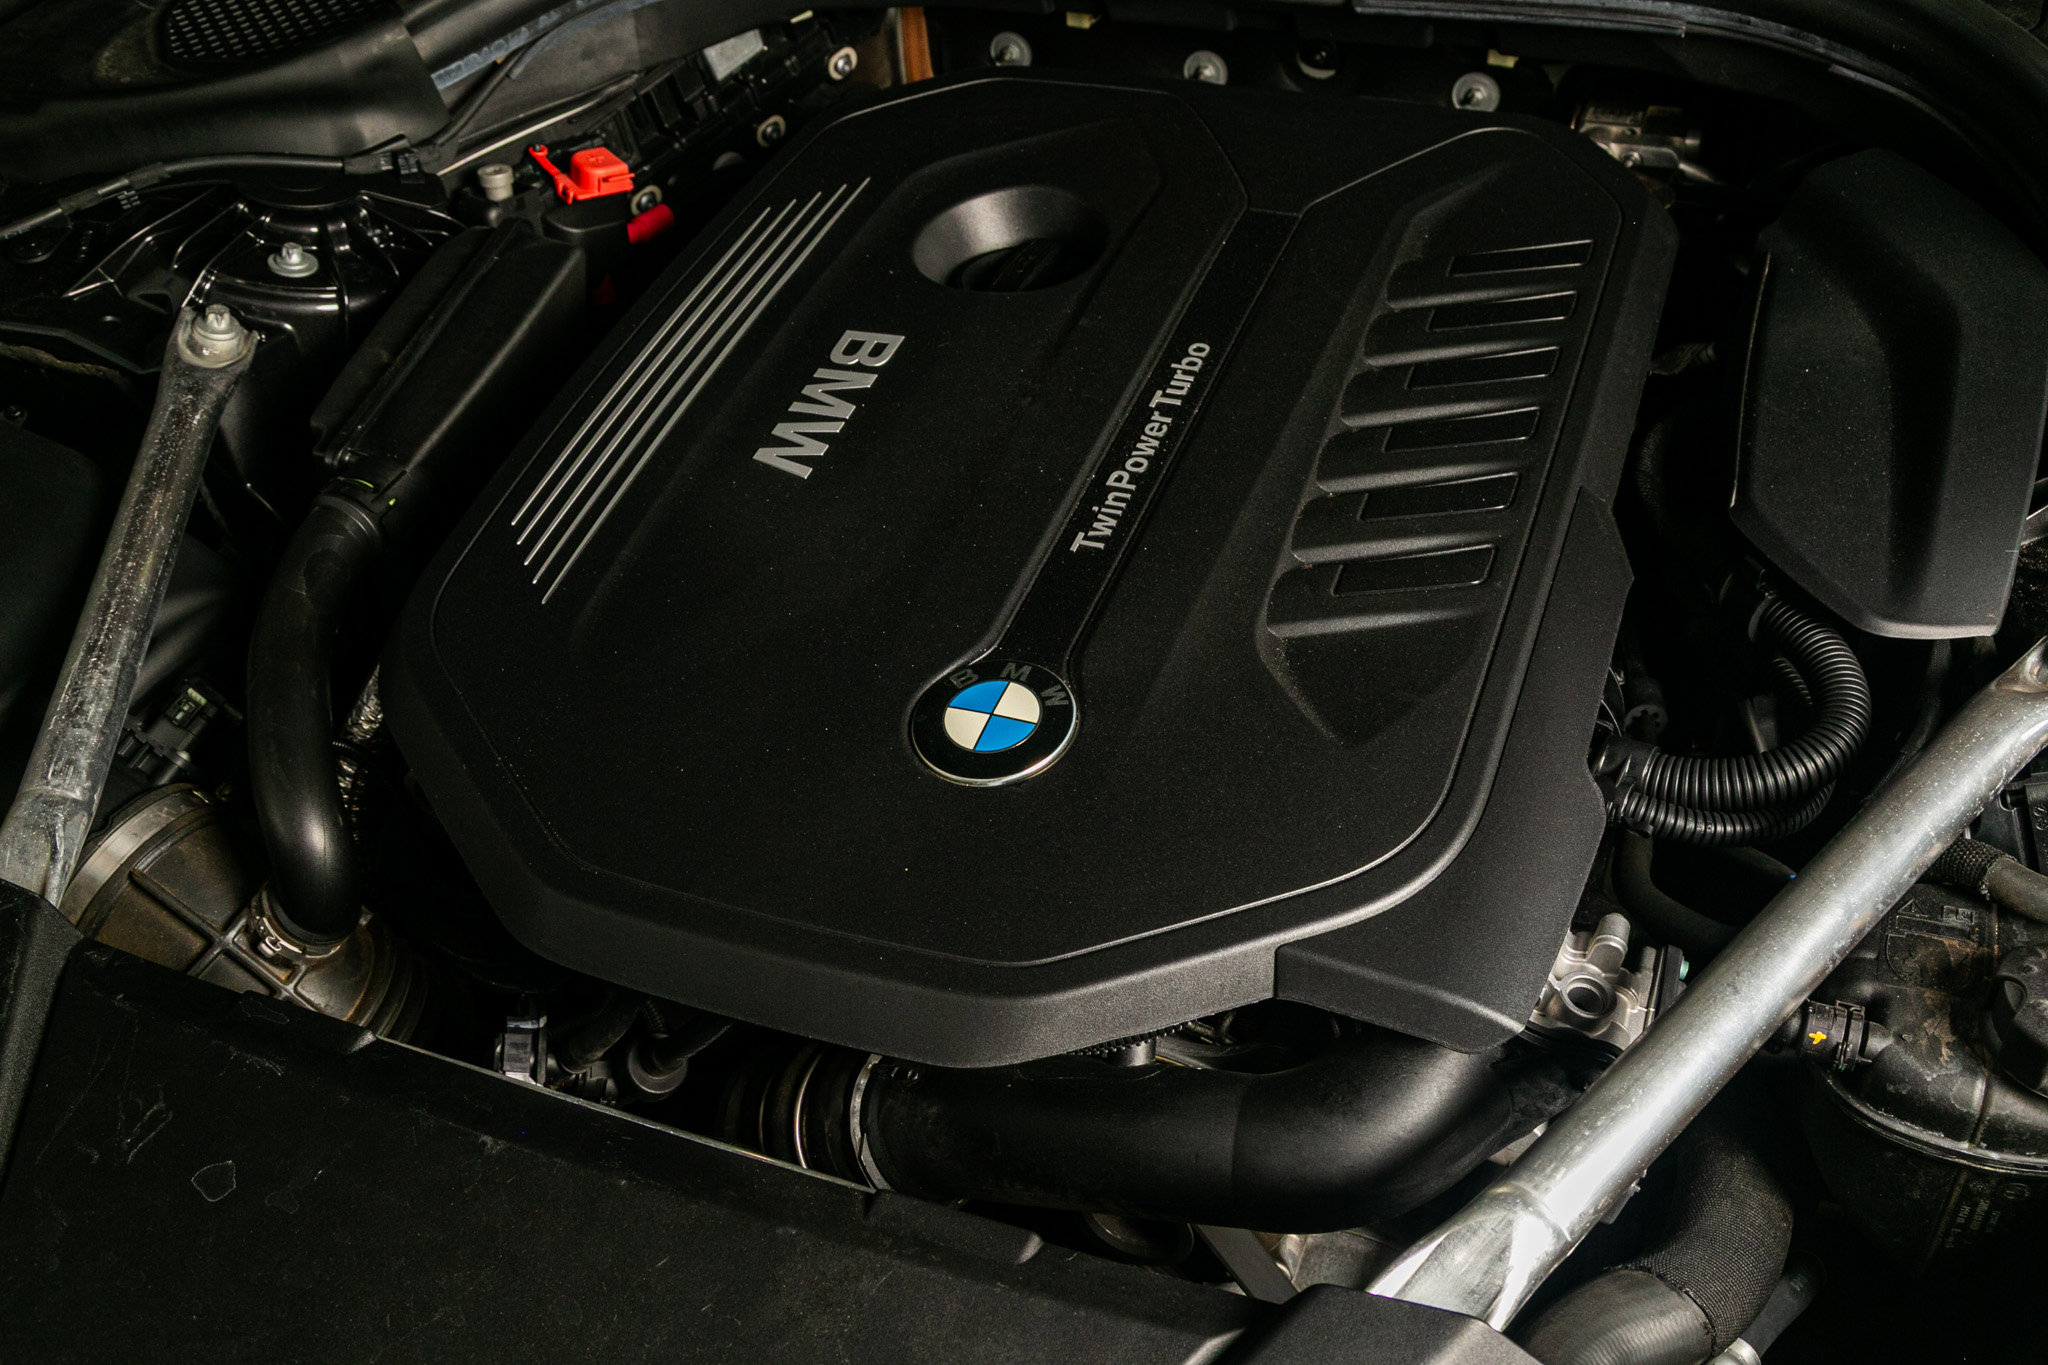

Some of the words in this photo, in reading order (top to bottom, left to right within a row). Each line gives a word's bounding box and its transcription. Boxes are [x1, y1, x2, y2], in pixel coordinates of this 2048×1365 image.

[752, 329, 905, 480] BMW
[1148, 341, 1211, 408] Turbo
[949, 661, 1070, 707] BMW
